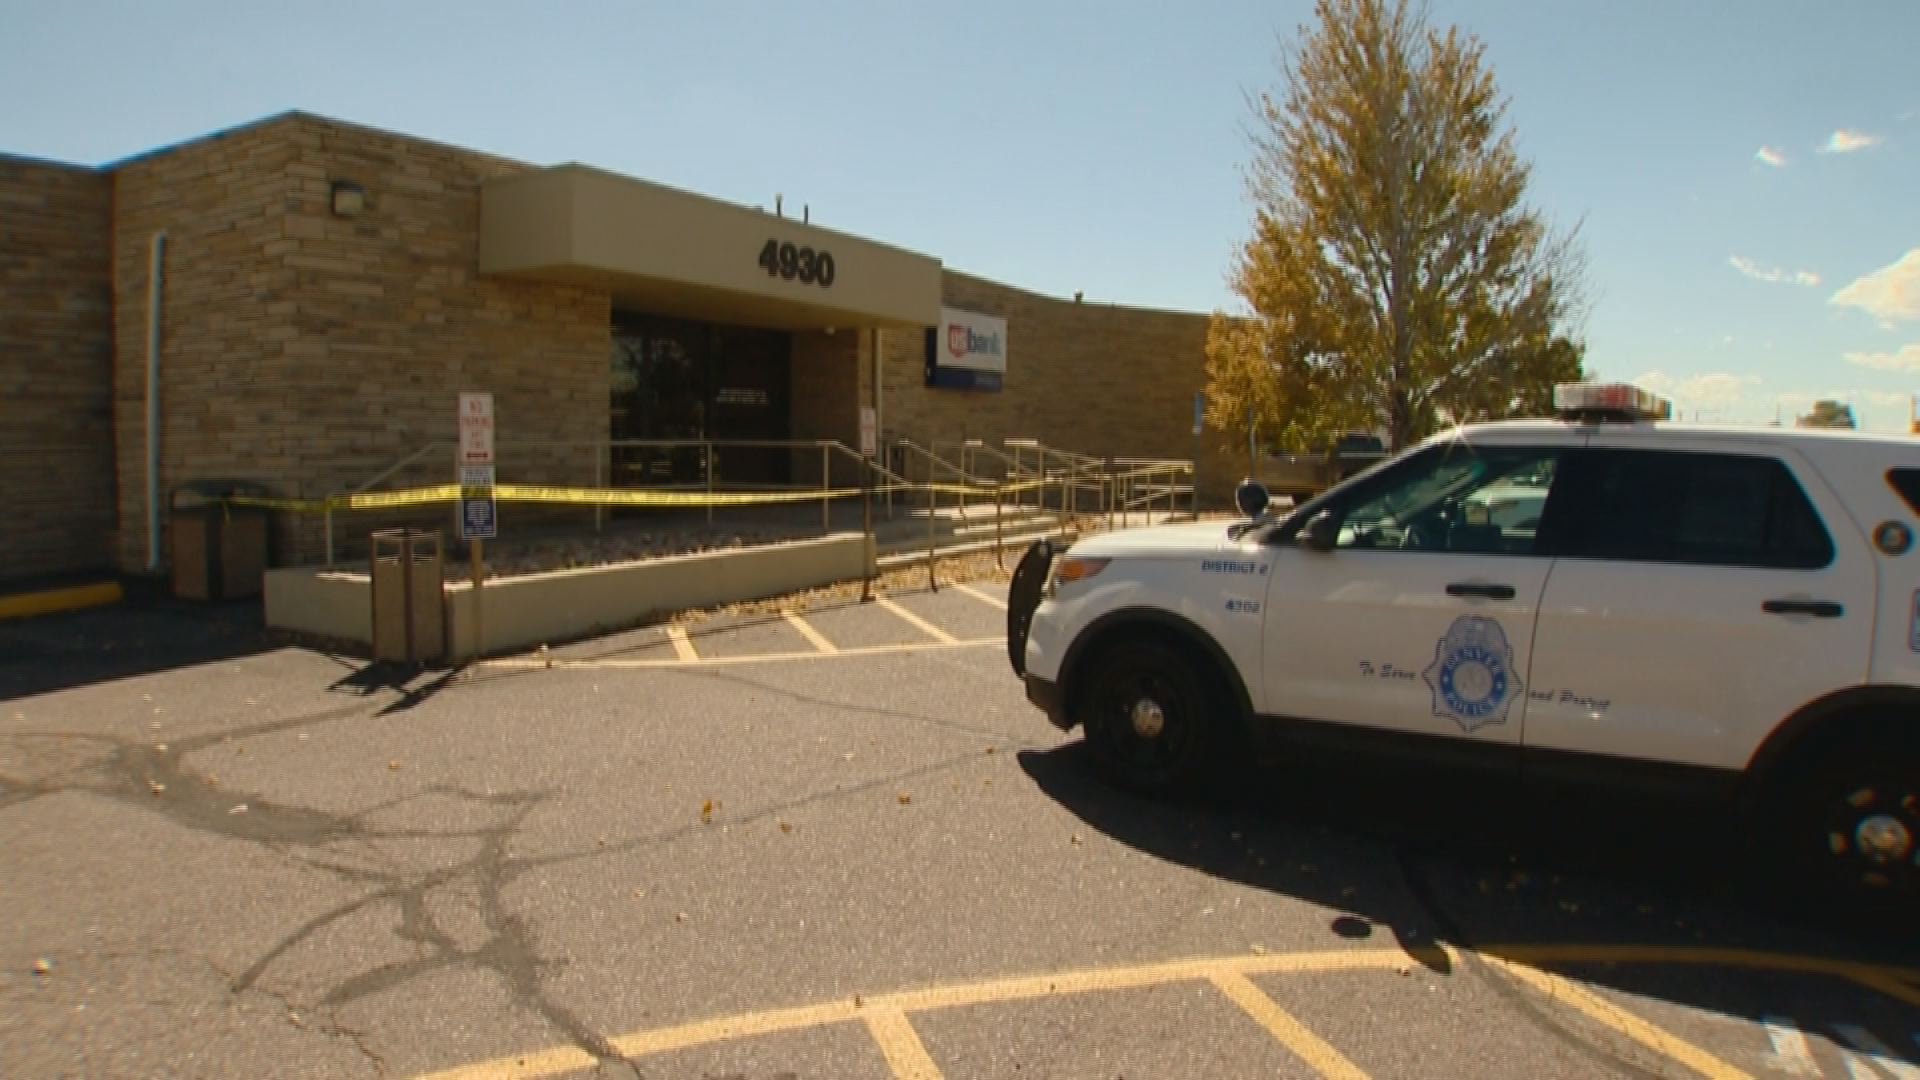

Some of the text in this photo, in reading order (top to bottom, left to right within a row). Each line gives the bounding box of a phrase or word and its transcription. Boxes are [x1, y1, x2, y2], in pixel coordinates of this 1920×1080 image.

[759, 238, 834, 287] 4930
[1201, 560, 1256, 573] DISTRICT
[1446, 647, 1502, 675] DENVER
[1446, 692, 1497, 714] POLICE
